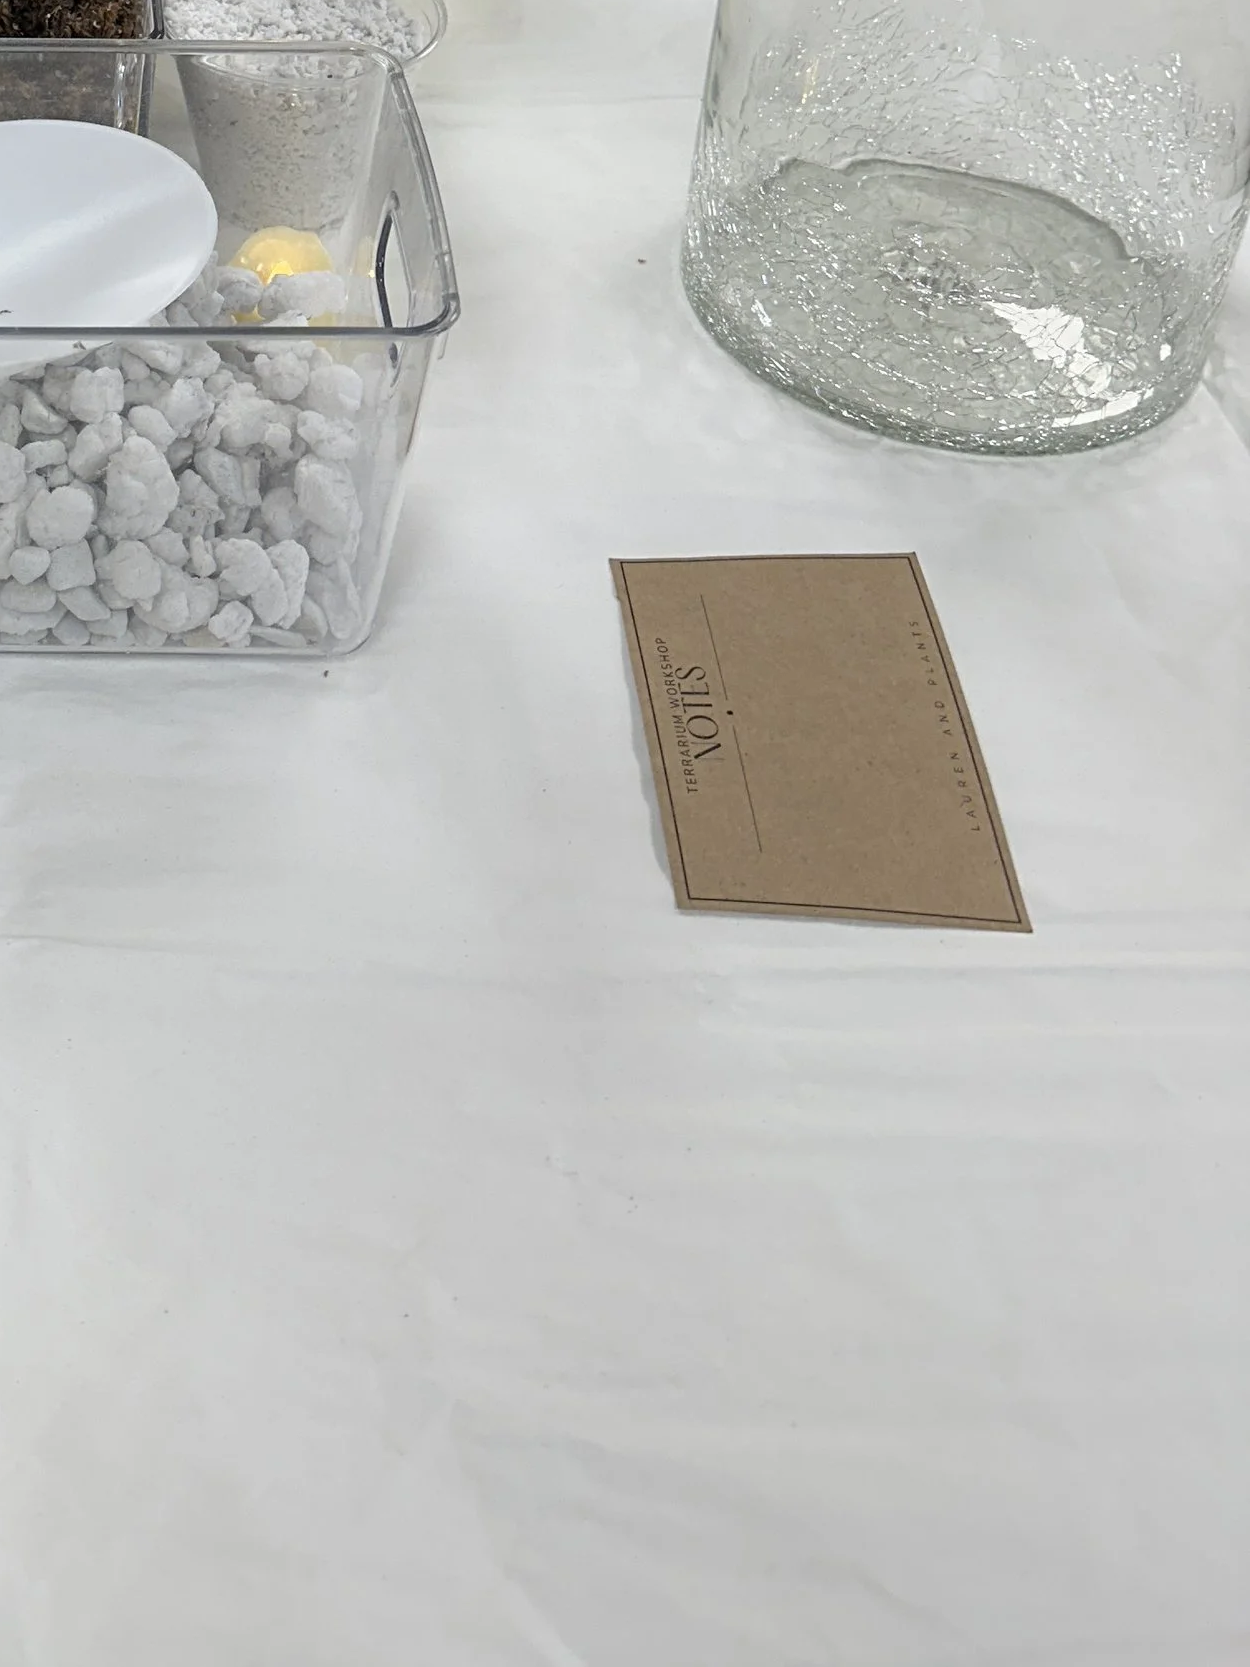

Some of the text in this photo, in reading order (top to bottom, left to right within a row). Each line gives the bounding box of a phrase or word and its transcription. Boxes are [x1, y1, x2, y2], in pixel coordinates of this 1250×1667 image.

[654, 636, 699, 795] TERRARIUM WORKSHOP
[674, 665, 726, 761] NOTES
[908, 620, 981, 833] LAUREN AND PLANTS
